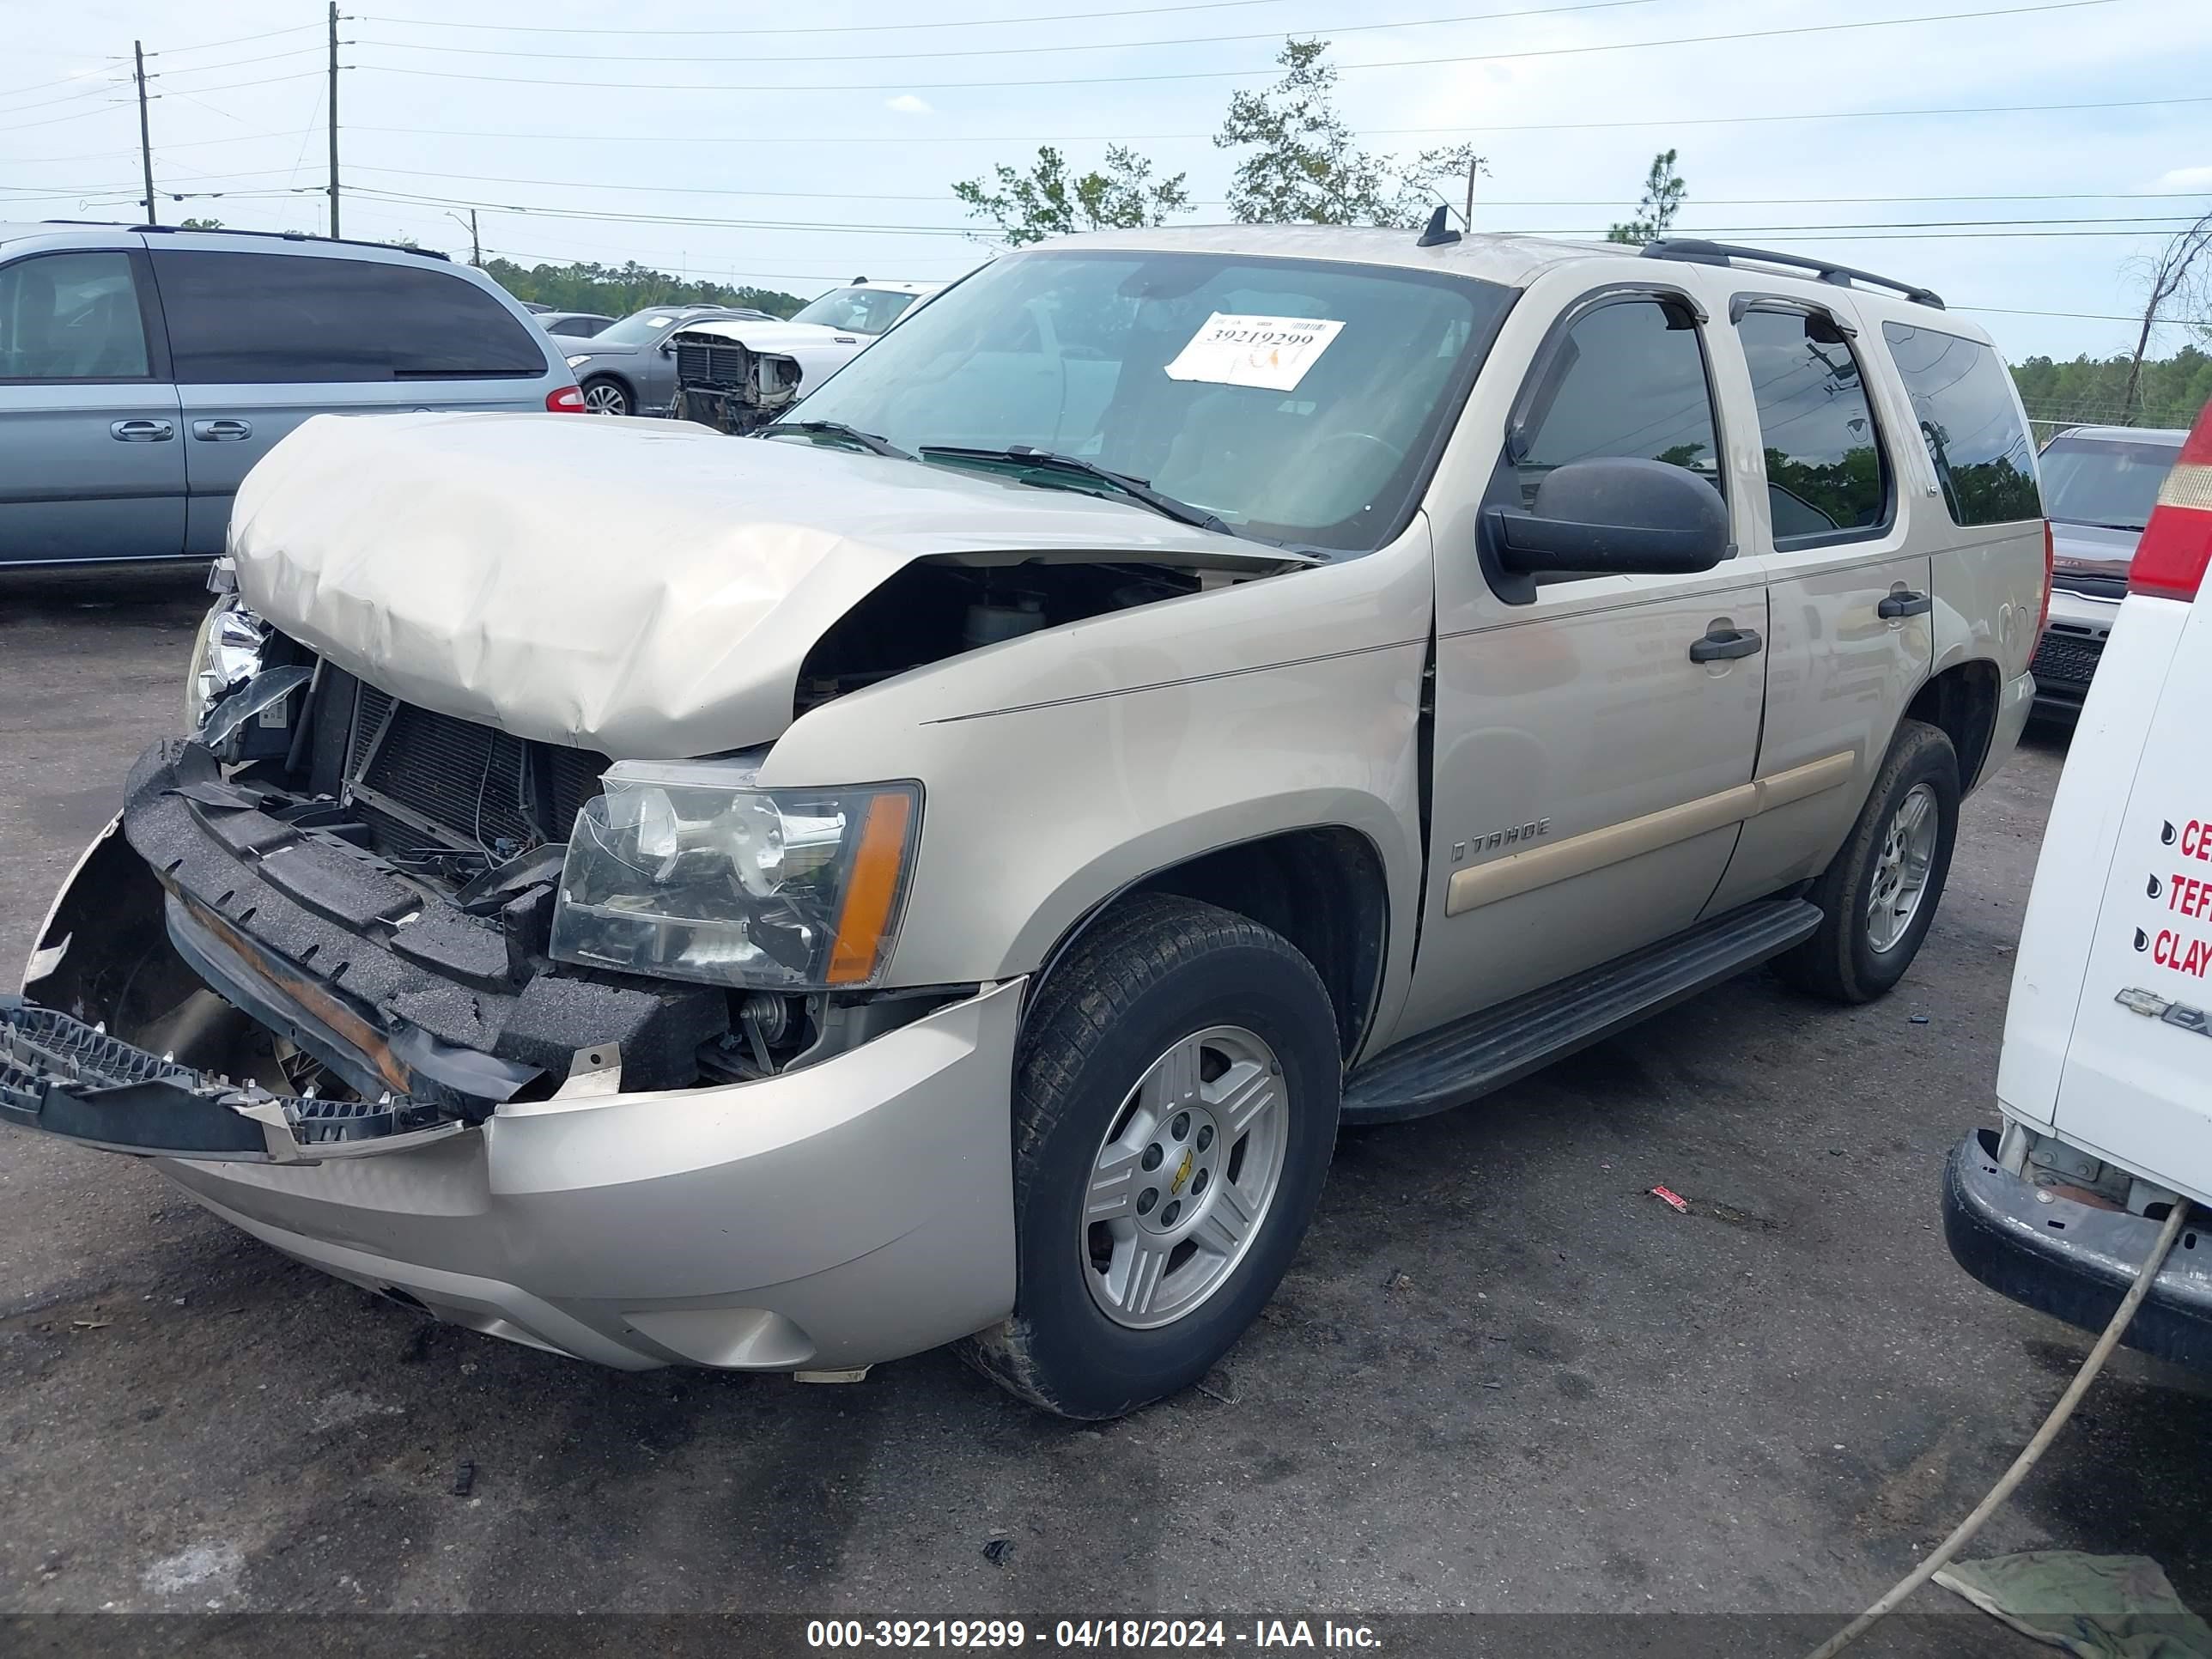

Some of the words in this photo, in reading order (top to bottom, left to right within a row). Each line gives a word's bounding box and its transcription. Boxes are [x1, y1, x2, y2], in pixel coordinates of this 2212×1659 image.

[1206, 329, 1314, 347] 39219299
[1472, 817, 1552, 854] TAHOE
[2181, 819, 2212, 862] CE
[2168, 873, 2212, 923] TEF
[2153, 929, 2212, 979] CLAY
